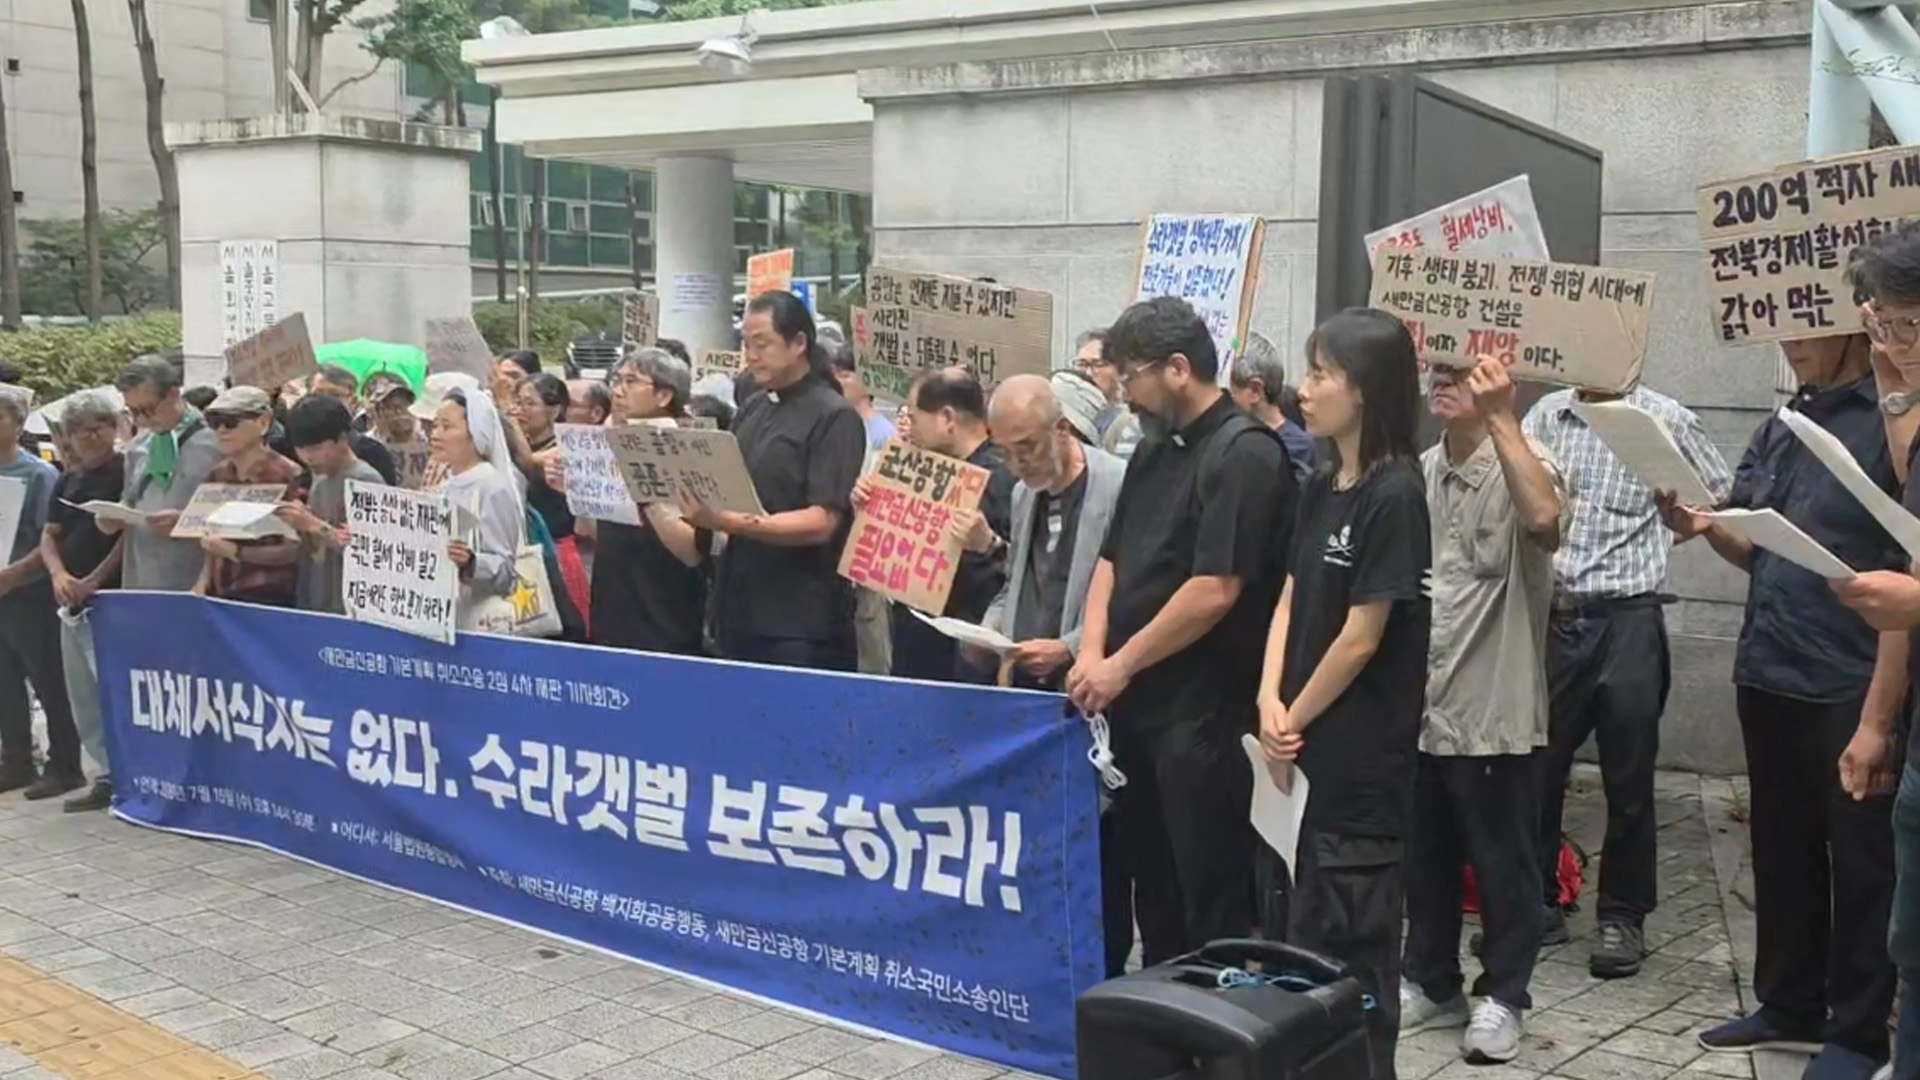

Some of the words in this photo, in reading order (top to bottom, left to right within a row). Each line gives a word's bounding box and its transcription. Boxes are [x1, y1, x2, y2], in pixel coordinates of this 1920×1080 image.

[1713, 170, 1810, 228] 200억
[1814, 161, 1878, 205] 적자
[1440, 202, 1513, 251] 혈세낭비.
[1382, 291, 1470, 318] 새만금신공항
[1479, 299, 1523, 328] 건설은
[1508, 264, 1548, 297] 전쟁
[1550, 269, 1585, 301] 위협
[1588, 279, 1647, 306] 시대에
[872, 308, 910, 331] 사라진
[1720, 292, 1779, 341] 갉아
[1787, 283, 1835, 328] 먹는
[879, 445, 956, 502] 군산공항
[418, 551, 437, 580] 말고
[437, 663, 485, 690] 취소소송
[511, 676, 533, 697] 4차
[535, 677, 562, 701] 재판
[346, 709, 459, 797] 없다.
[468, 733, 689, 852] 수라갯벌
[706, 773, 1022, 913] 보존하라!
[519, 875, 599, 913] 새만금신공항
[601, 892, 710, 943] 백지화공동행동,
[715, 919, 809, 964] 새만금신공항
[814, 943, 879, 983] 기본계획
[884, 959, 1030, 1023] 취소국민소송인단
